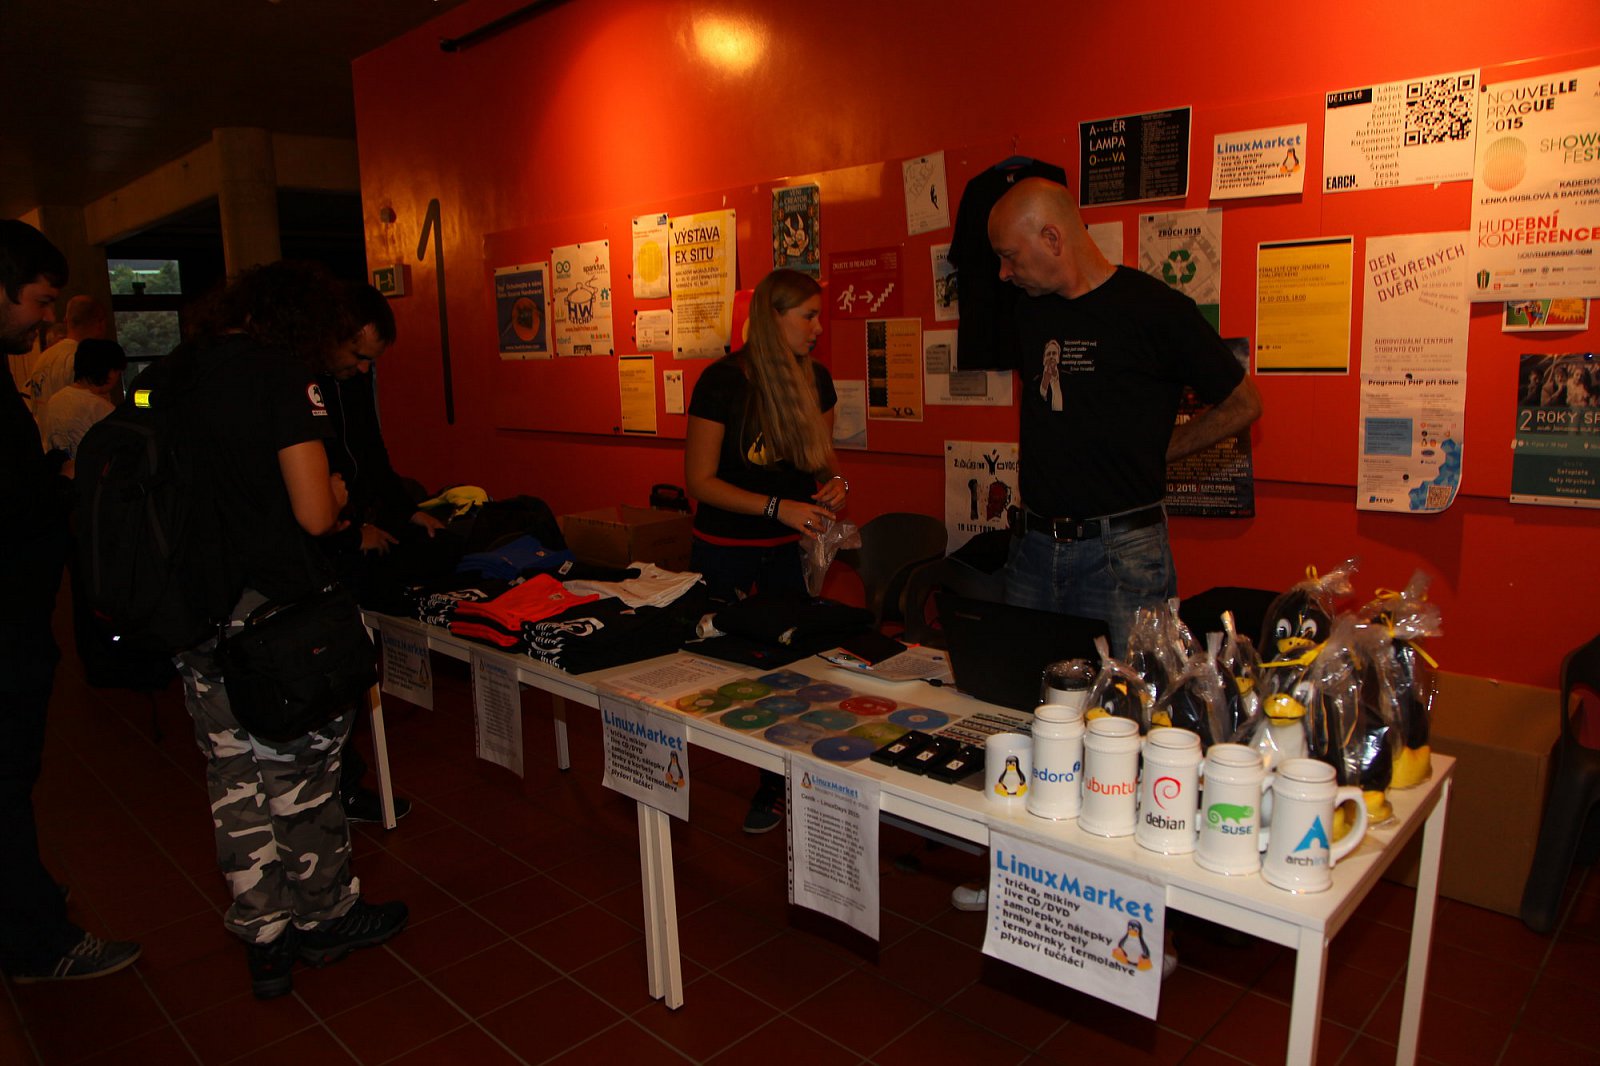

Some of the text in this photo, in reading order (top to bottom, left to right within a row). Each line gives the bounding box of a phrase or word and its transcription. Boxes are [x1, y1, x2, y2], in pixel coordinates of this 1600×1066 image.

[1488, 79, 1578, 104] NOUVELLE
[1487, 98, 1555, 119] PRAGUE
[1486, 116, 1524, 134] 2015
[1089, 136, 1126, 152] LAMPA
[1217, 135, 1301, 154] LinuxMarket
[1326, 174, 1358, 190] EARCH.
[1479, 209, 1559, 234] HUDEBNÍ
[674, 226, 720, 245] VÝSTAVA
[1478, 226, 1600, 248] KONFERENCE
[675, 246, 714, 264] EX SITU
[1369, 252, 1396, 272] DEN
[1373, 244, 1465, 286] OTEVŘENÝCH
[568, 300, 593, 320] HW
[1520, 409, 1532, 430] 2
[1536, 411, 1578, 423] ROKY
[604, 709, 682, 751] LinuxMarket
[1032, 766, 1074, 783] edora
[812, 774, 858, 798] LinuxMarket
[1086, 777, 1135, 795] ubuntu
[1146, 813, 1185, 830] debian
[996, 851, 1154, 923] LinuxMarket
[1005, 878, 1080, 912] trička, mikiny
[1004, 887, 1070, 917] live CD/DVD
[1002, 910, 1032, 927] hrnky
[1045, 924, 1089, 947] korbely
[1004, 900, 1113, 946] samolepky, nálepky
[1001, 931, 1084, 968] plyšoví tučňáci
[1002, 920, 1135, 976] termohrnky, termolahve
